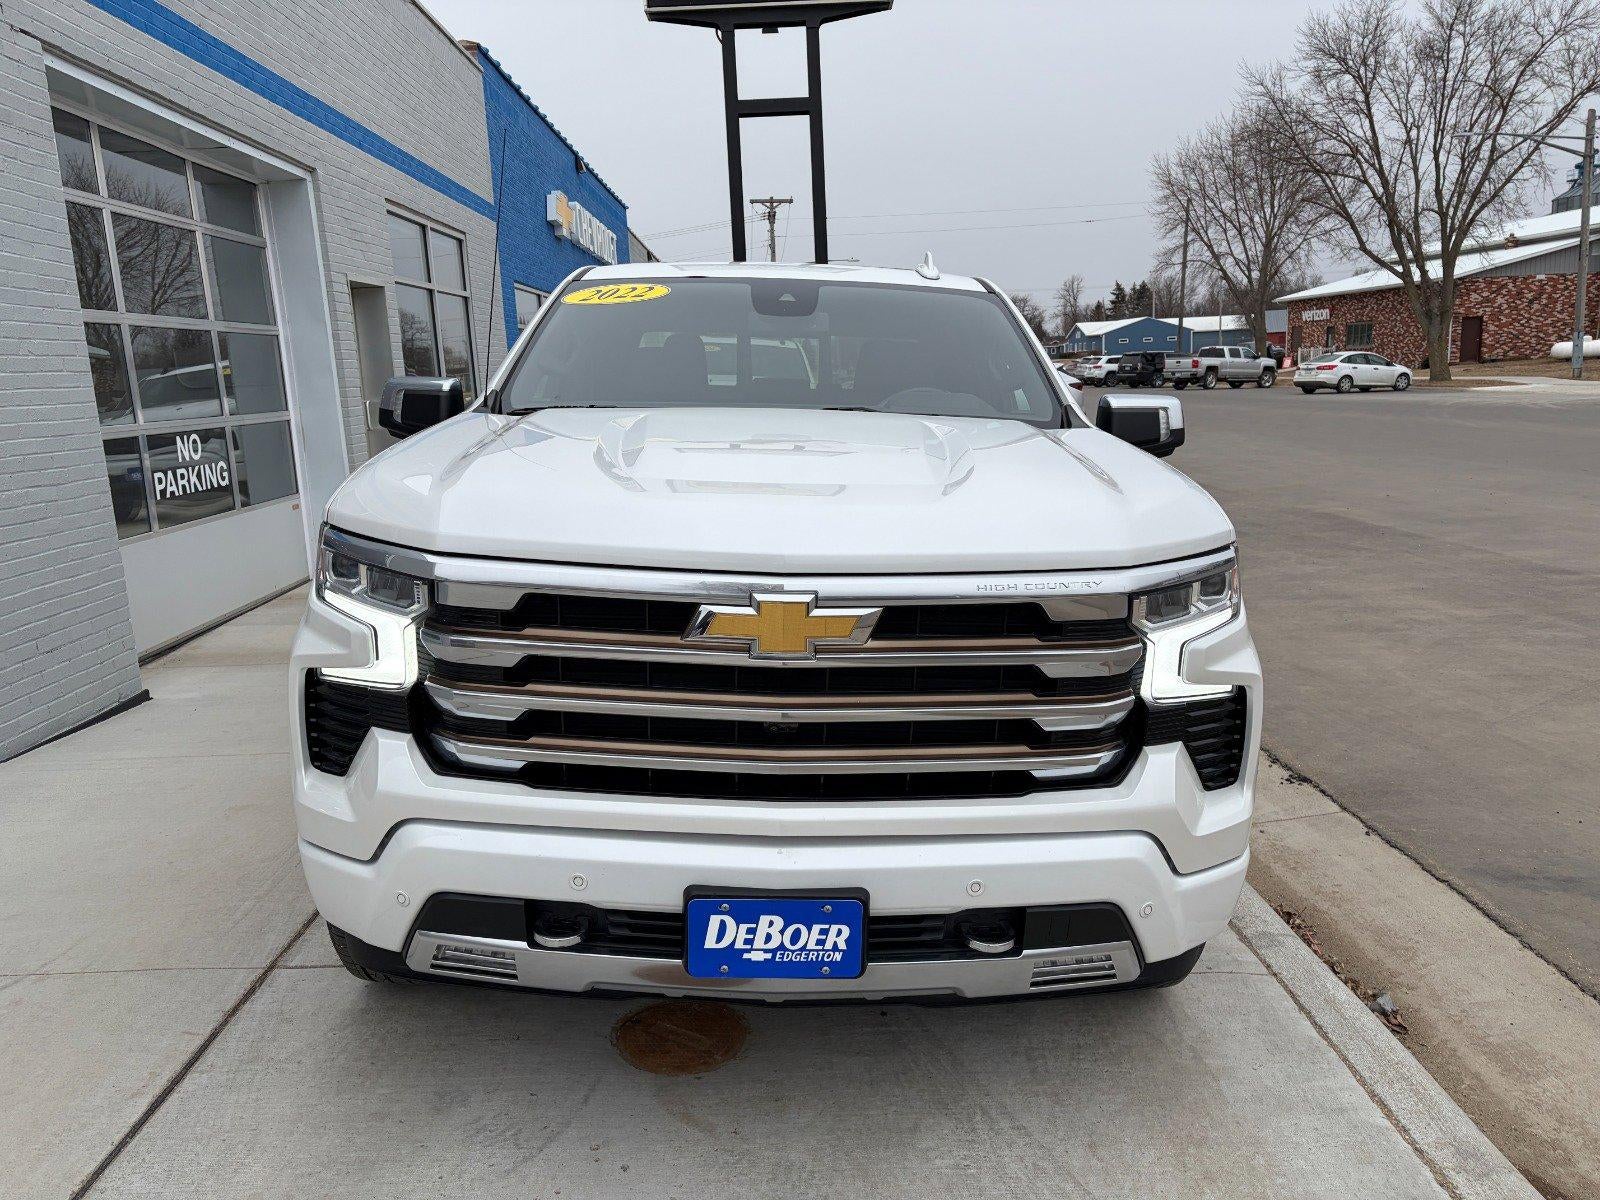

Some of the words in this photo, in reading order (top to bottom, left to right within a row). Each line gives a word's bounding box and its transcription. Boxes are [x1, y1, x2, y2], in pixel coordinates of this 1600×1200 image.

[578, 285, 655, 302] 2022
[1302, 306, 1330, 321] verizon
[176, 433, 202, 462] NO
[153, 460, 230, 500] PARKING
[976, 583, 1019, 592] HIGH
[1024, 580, 1104, 591] COUNTRY
[775, 951, 843, 962] EDGERTON
